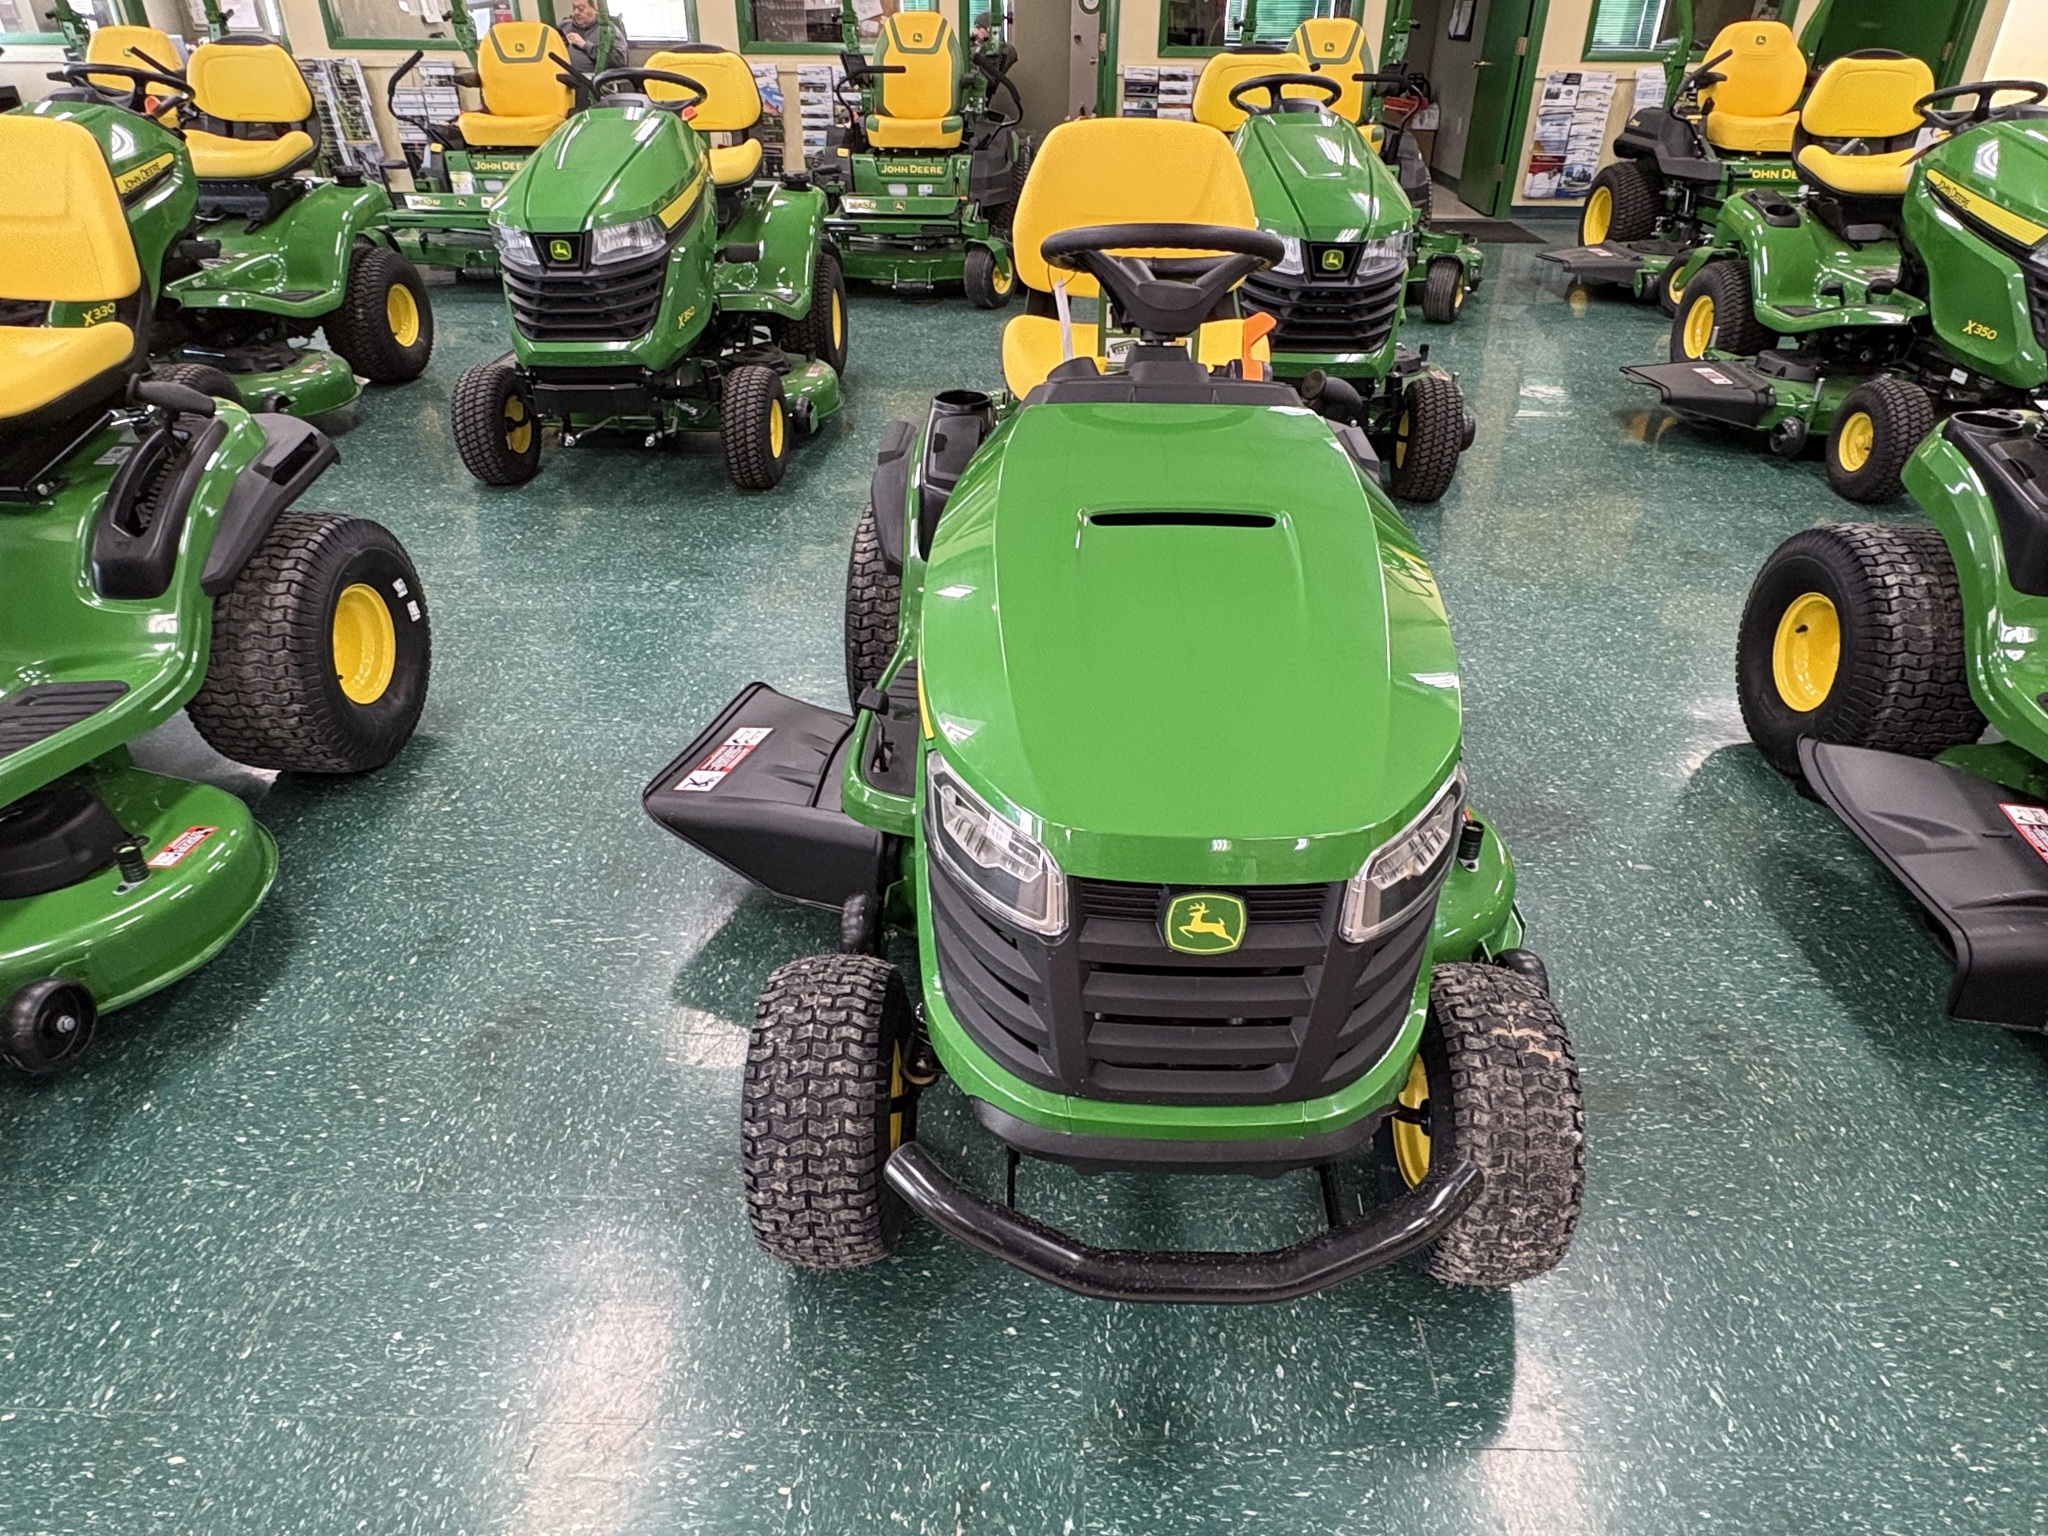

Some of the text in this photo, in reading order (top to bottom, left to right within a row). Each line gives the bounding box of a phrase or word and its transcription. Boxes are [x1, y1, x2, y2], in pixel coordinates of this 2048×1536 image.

[474, 161, 522, 171] JOHN DEE
[881, 164, 944, 174] JOHN DEERE
[82, 302, 116, 327] X330
[1962, 319, 1998, 340] X350
